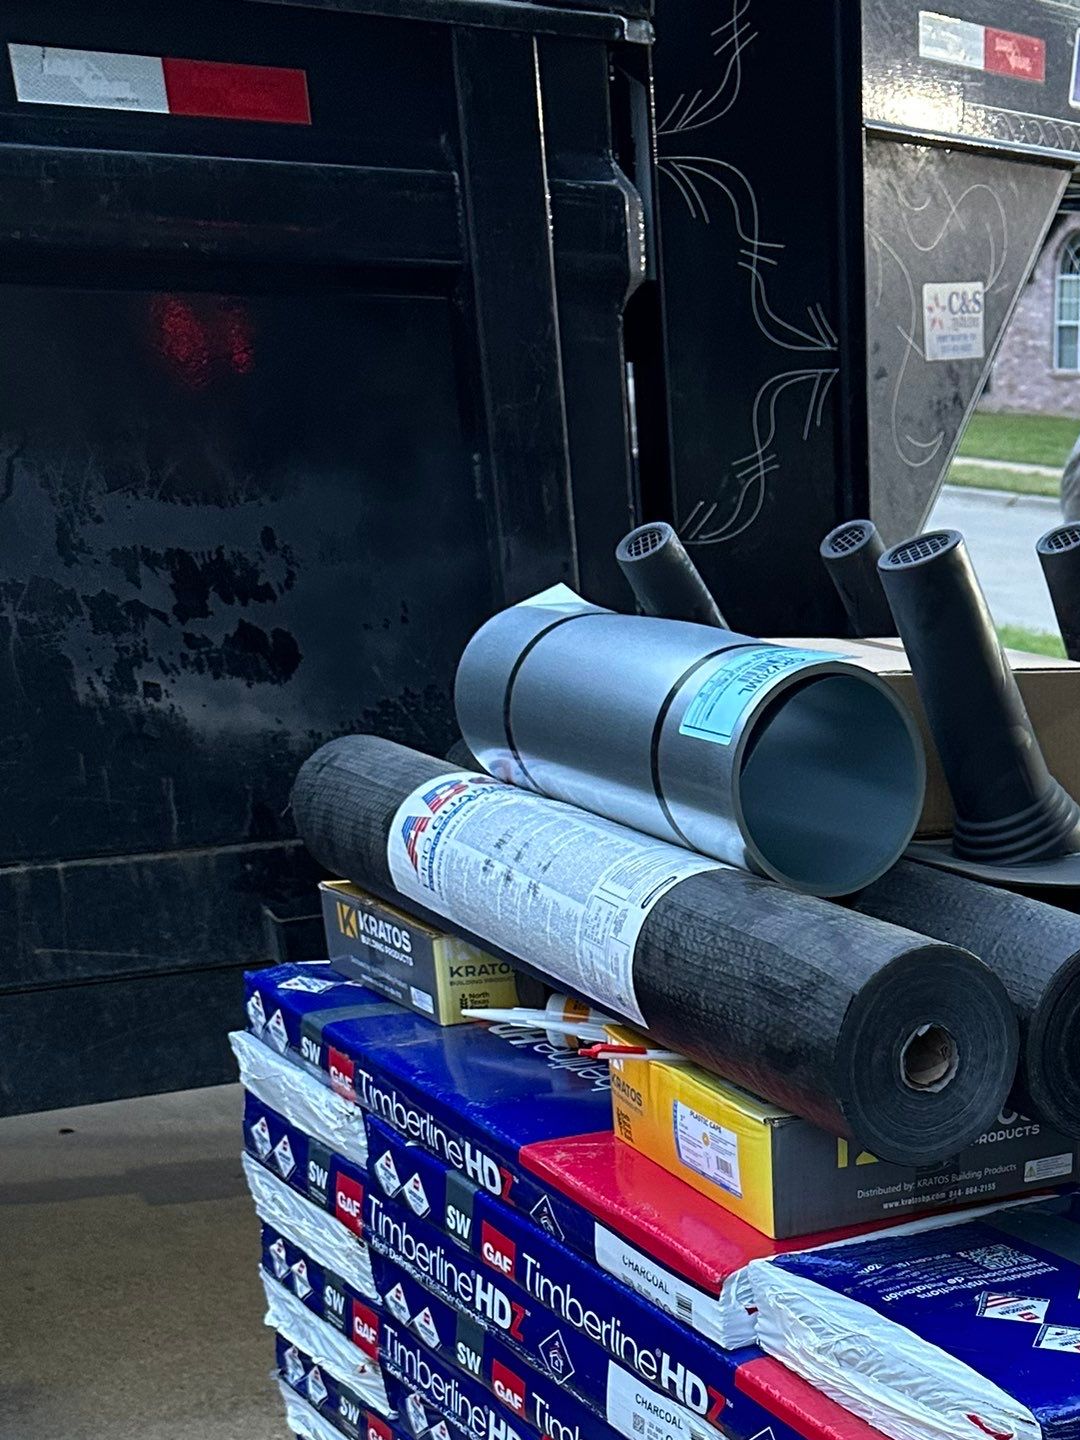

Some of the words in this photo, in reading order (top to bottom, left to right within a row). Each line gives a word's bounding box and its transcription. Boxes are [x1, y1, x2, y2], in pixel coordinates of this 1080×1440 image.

[357, 910, 412, 953] KRATOS
[972, 1124, 1041, 1145] RODUCTS
[857, 1182, 901, 1199] Distributed
[917, 1174, 950, 1188] KRATOS
[951, 1169, 982, 1183] Building
[983, 1162, 1017, 1178] Products
[336, 1191, 361, 1218] GAF
[446, 1204, 472, 1239] SW
[325, 1285, 345, 1310] SW
[353, 1315, 378, 1345] GAF
[456, 1341, 482, 1376] SW
[634, 1393, 684, 1431] CHARCOAL
